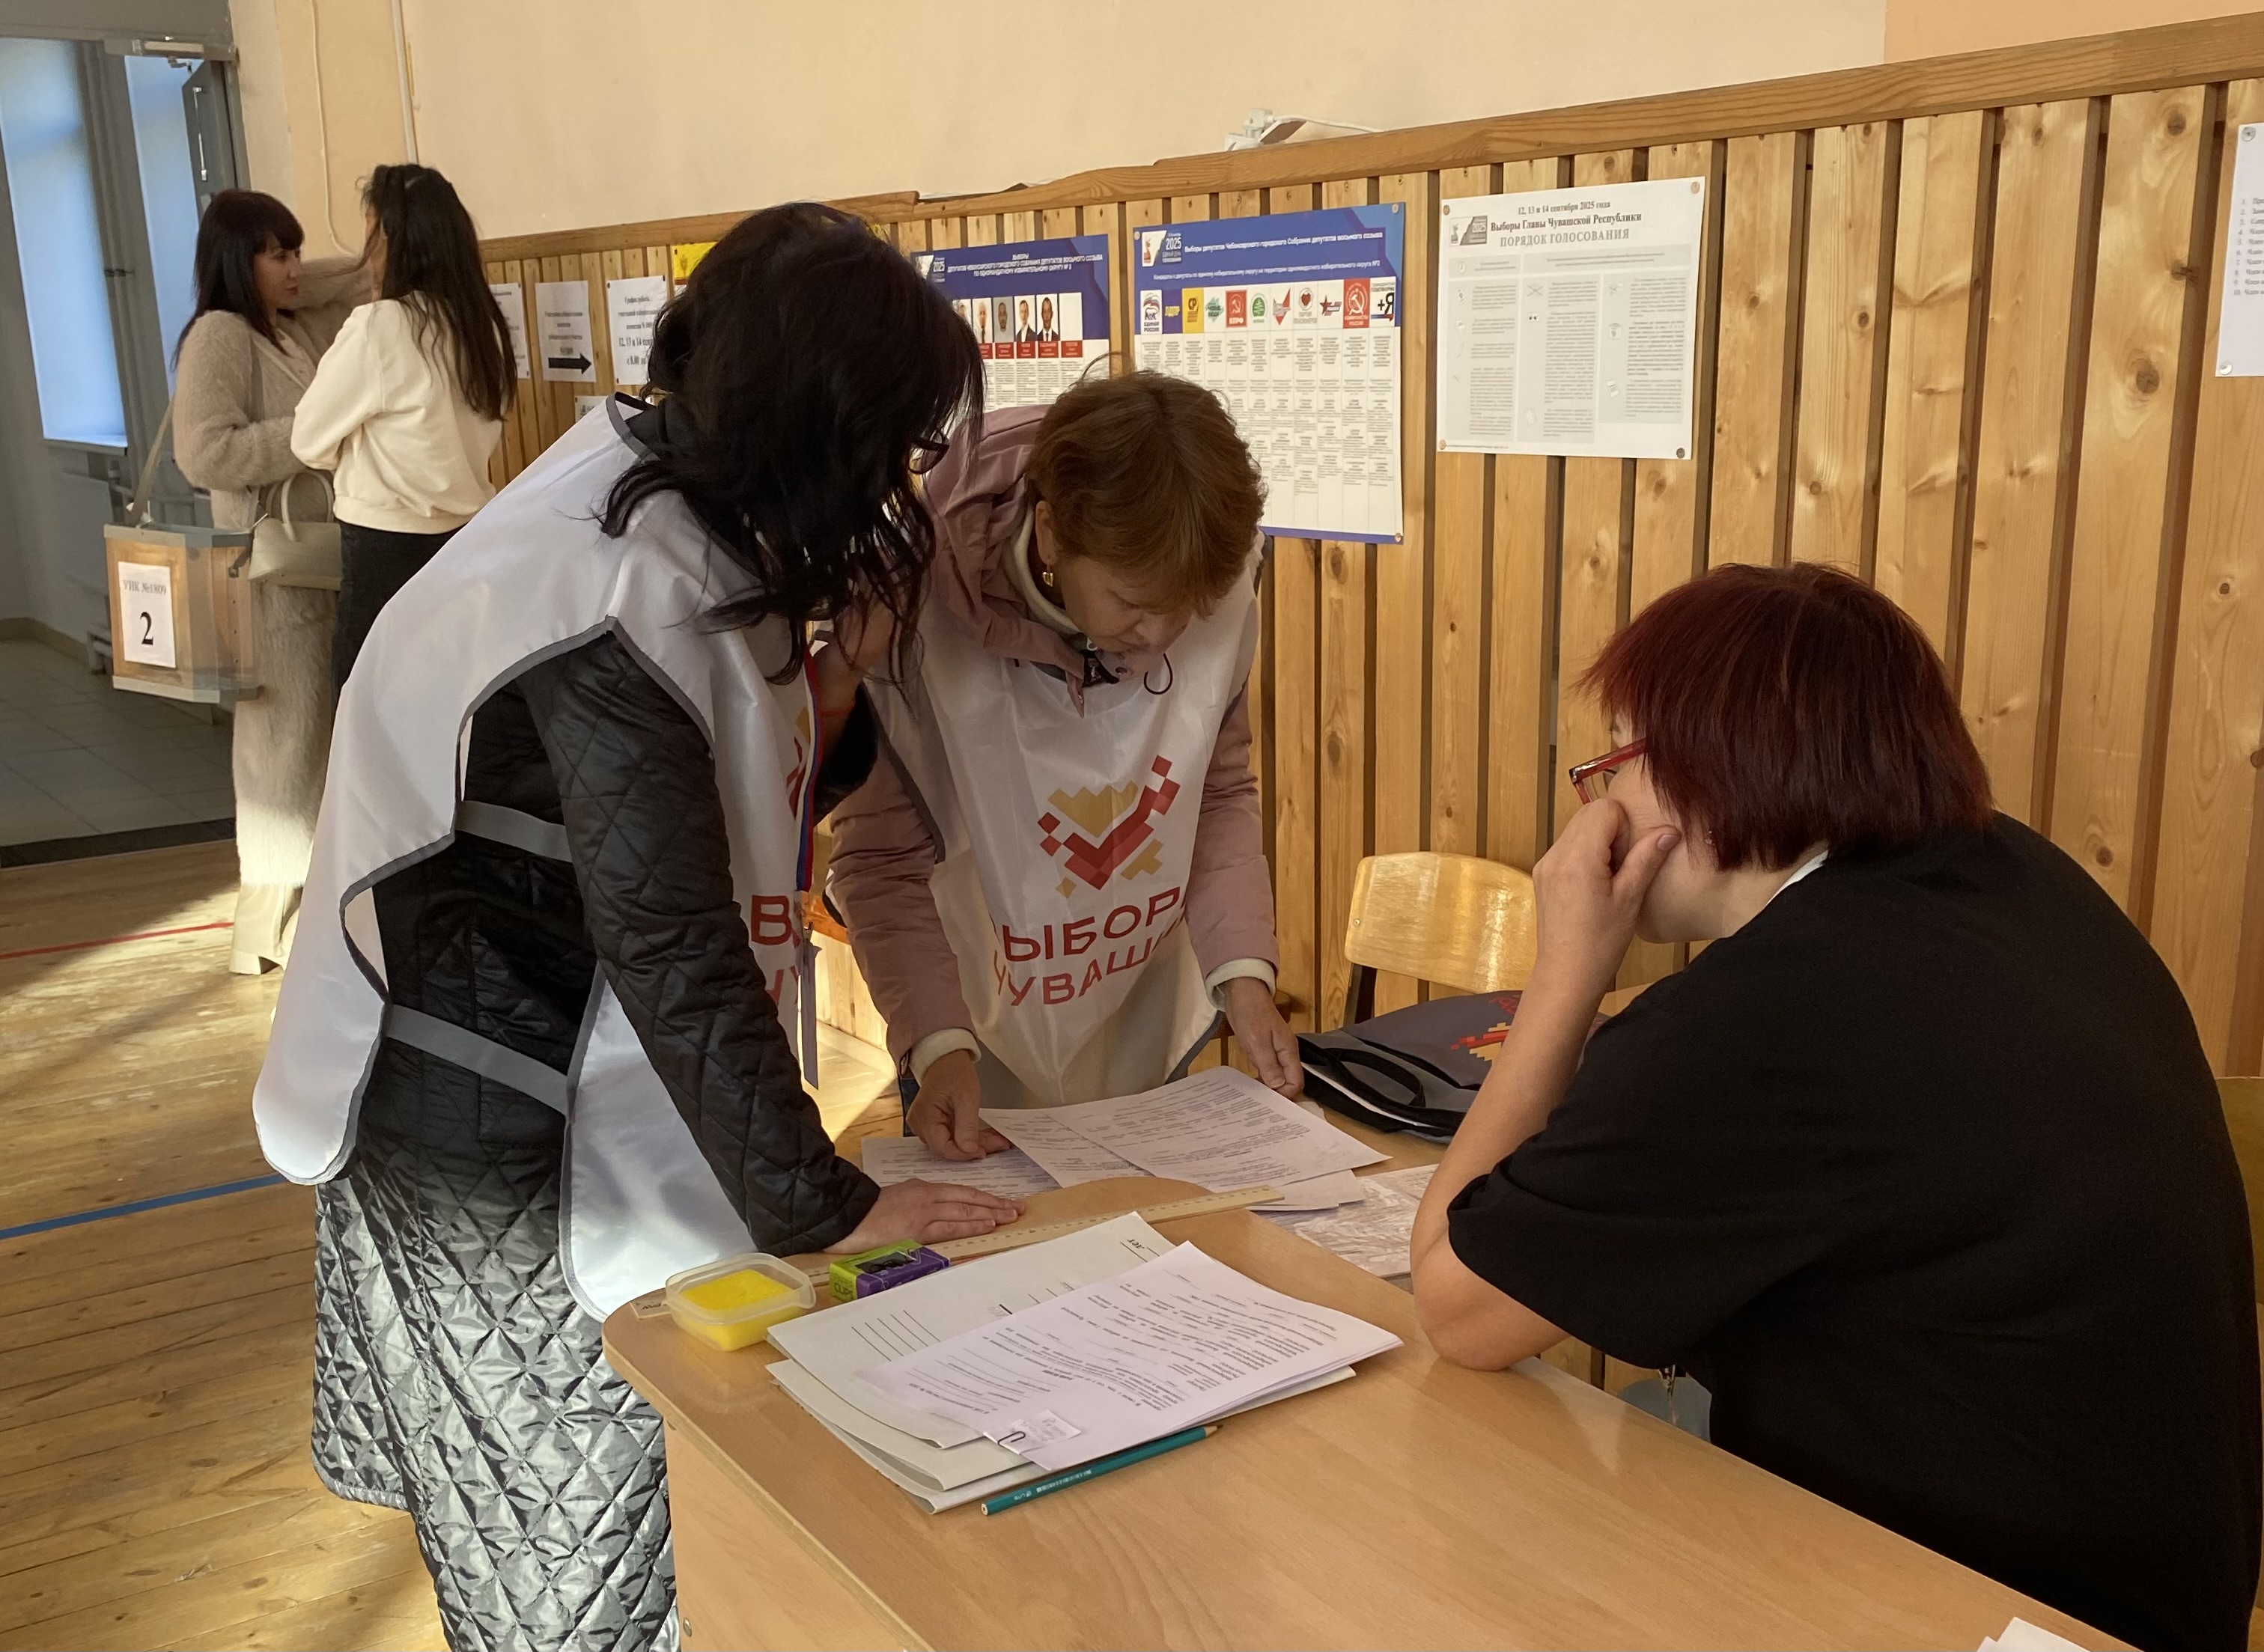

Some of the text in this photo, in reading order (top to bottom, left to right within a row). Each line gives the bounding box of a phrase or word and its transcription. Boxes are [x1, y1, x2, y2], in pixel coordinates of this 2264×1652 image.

[1528, 206, 1535, 214] 13
[1551, 203, 1578, 213] сентября
[1580, 201, 1595, 210] 2025
[1491, 213, 1642, 232] Выборы Главы Чувашской Республики
[1166, 237, 1182, 250] 2025
[1500, 228, 1629, 247] ПОРЯДОК ГОЛОСОВАНИЯ
[140, 612, 153, 646] 2
[994, 886, 1184, 962] ЫБОР
